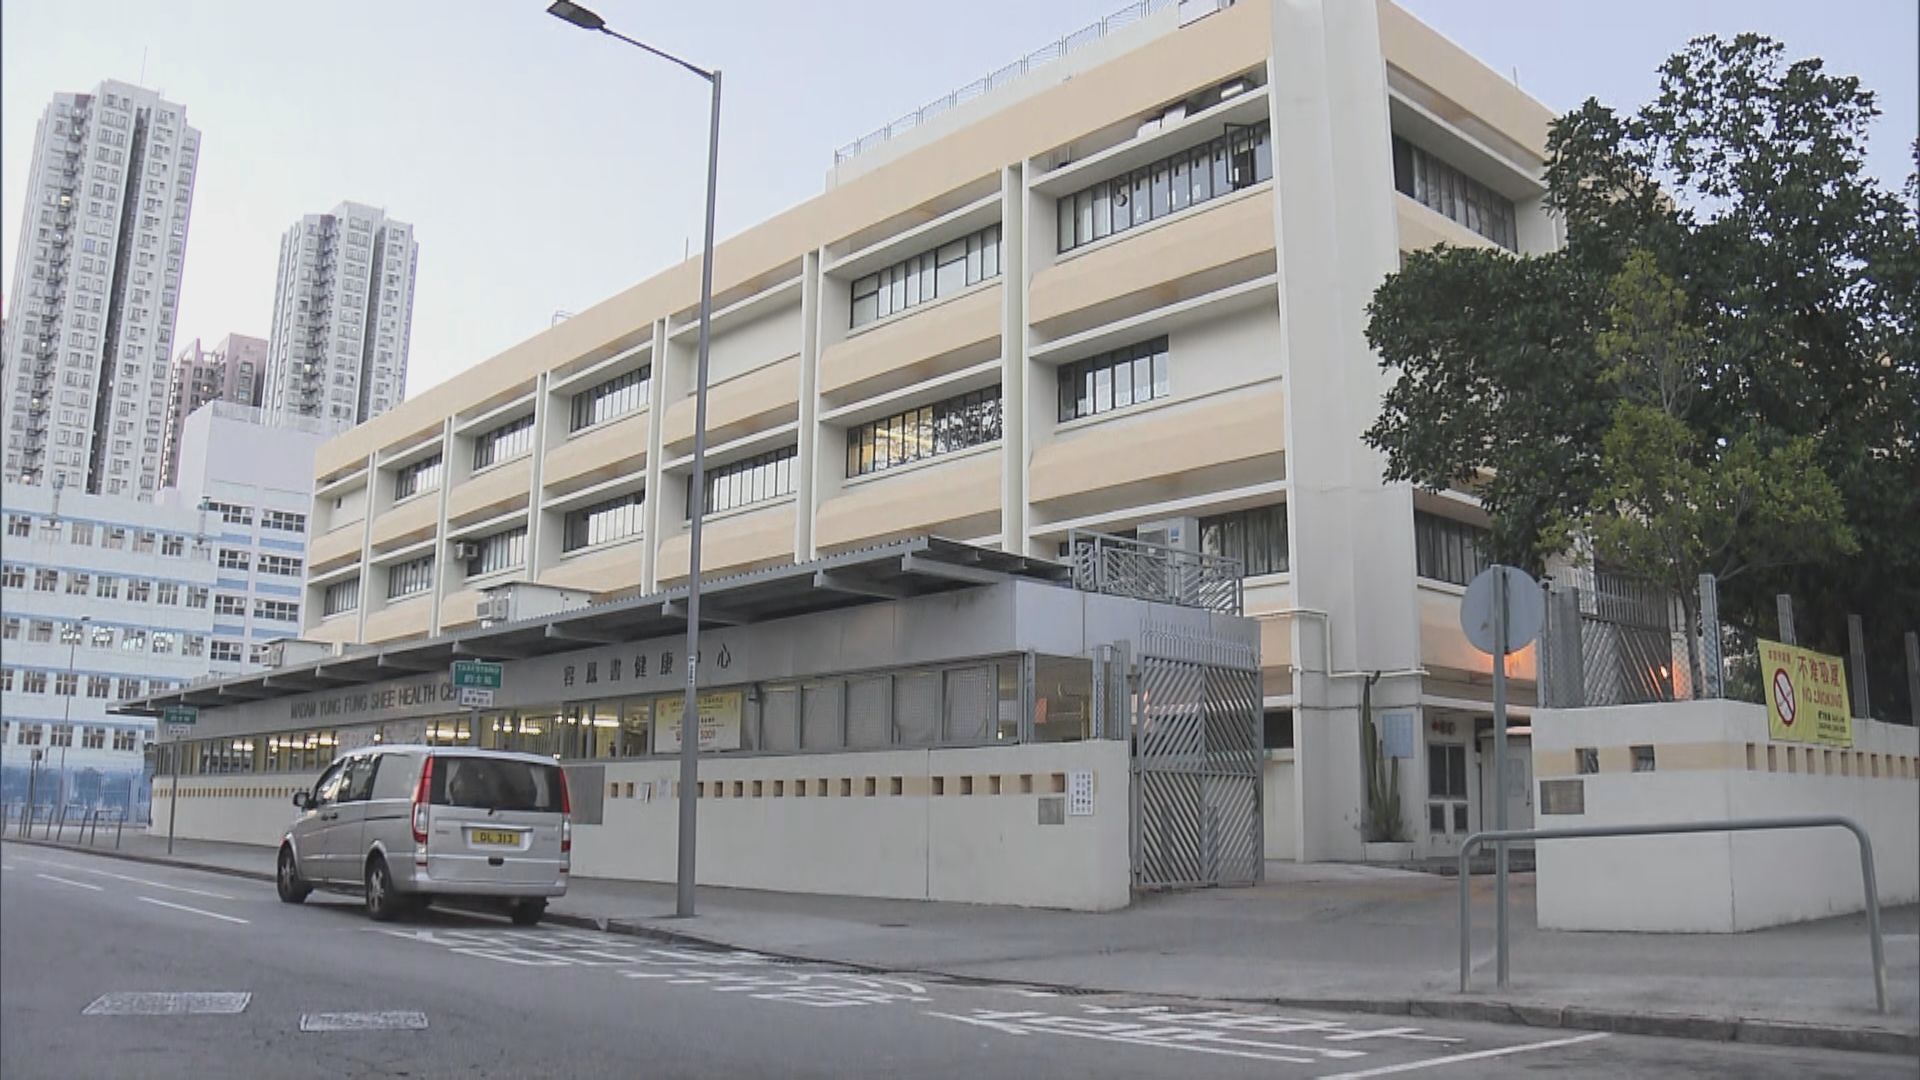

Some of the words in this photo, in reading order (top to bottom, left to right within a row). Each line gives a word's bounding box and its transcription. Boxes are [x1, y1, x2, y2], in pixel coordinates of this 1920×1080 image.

[563, 643, 732, 687] 容鳳書健康心
[398, 684, 437, 707] HEALTH
